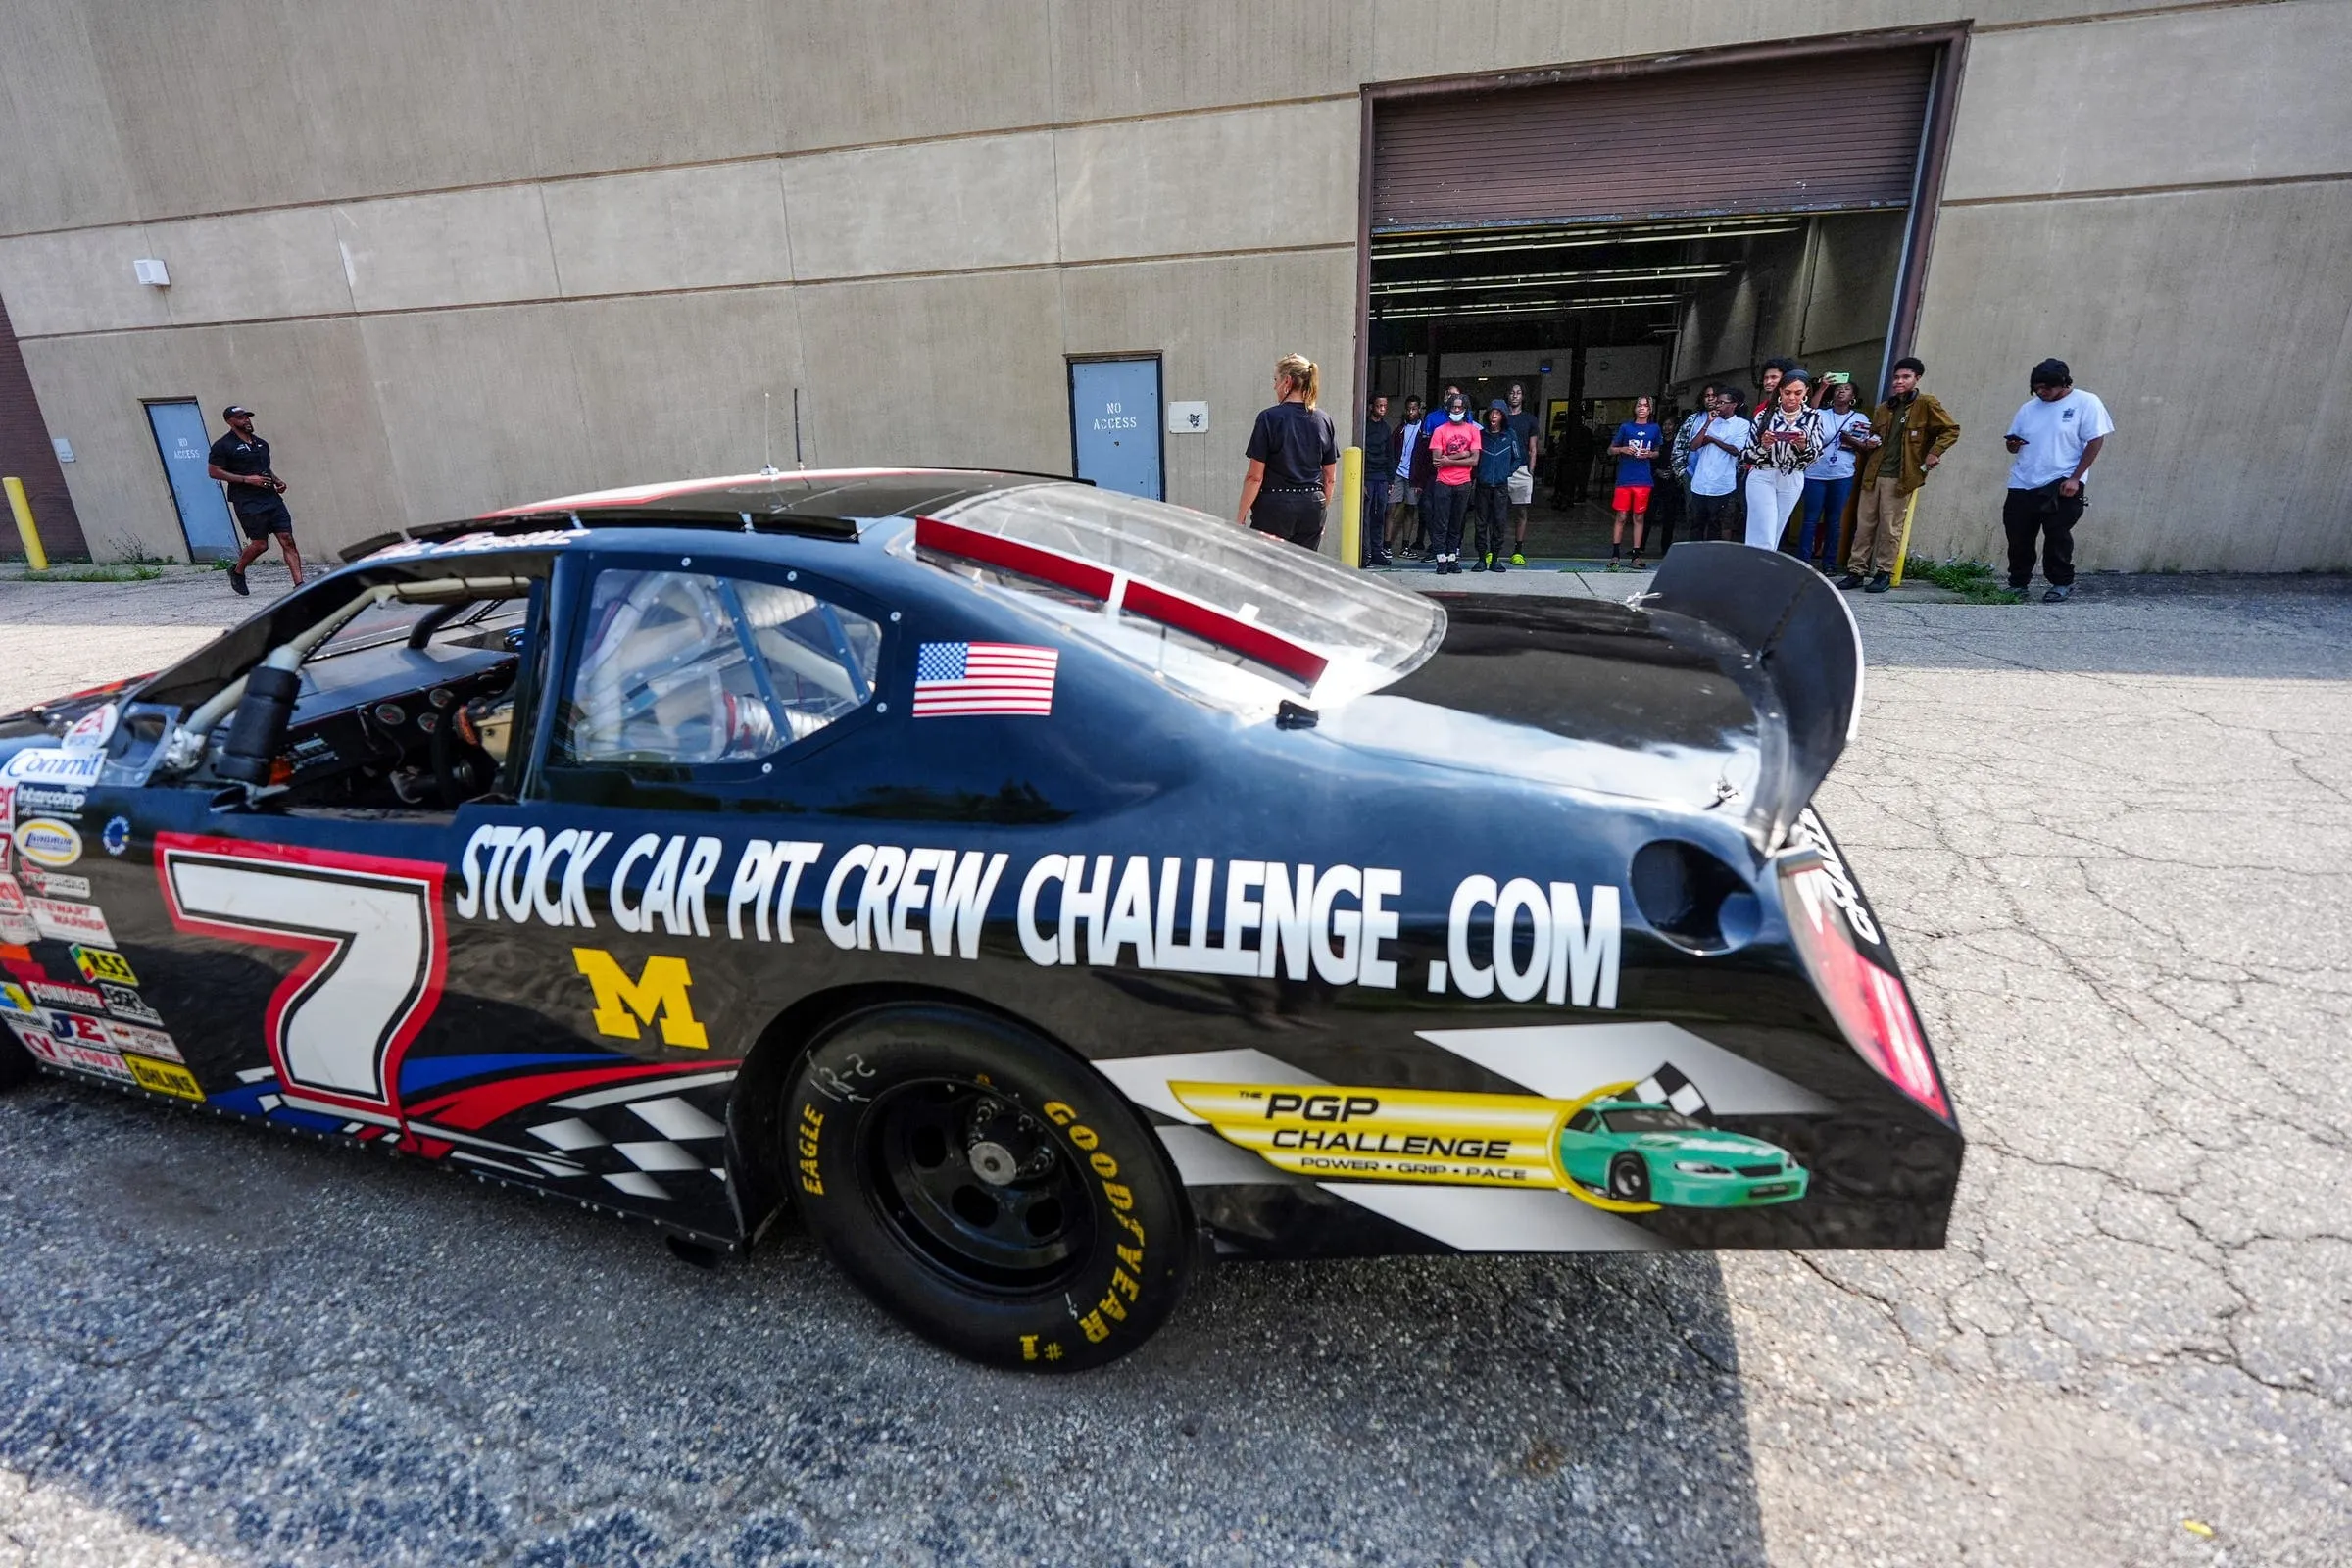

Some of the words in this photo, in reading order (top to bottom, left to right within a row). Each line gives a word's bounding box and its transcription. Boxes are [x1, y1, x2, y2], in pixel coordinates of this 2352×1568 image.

[1093, 416, 1138, 431] ACCESS
[1106, 401, 1122, 415] NO
[173, 448, 201, 460] ACCESS
[455, 823, 614, 929] STOCK
[609, 831, 723, 938] CAR
[726, 838, 825, 945] PIT
[820, 843, 1009, 961] CREW
[1016, 853, 1402, 989] CHALLENGE
[1427, 874, 1621, 1010] .COM
[84, 950, 131, 978] RSS
[157, 835, 446, 1115] 7
[571, 946, 710, 1051] M
[51, 1012, 107, 1043] JE
[1239, 1090, 1263, 1100] THE
[1265, 1092, 1380, 1123] PGP
[799, 1102, 826, 1197] EAGLE
[1271, 1129, 1512, 1160] CHALLENGE
[1300, 1156, 1379, 1171] POWER
[1397, 1162, 1447, 1175] GRIP
[1465, 1166, 1528, 1182] PACE
